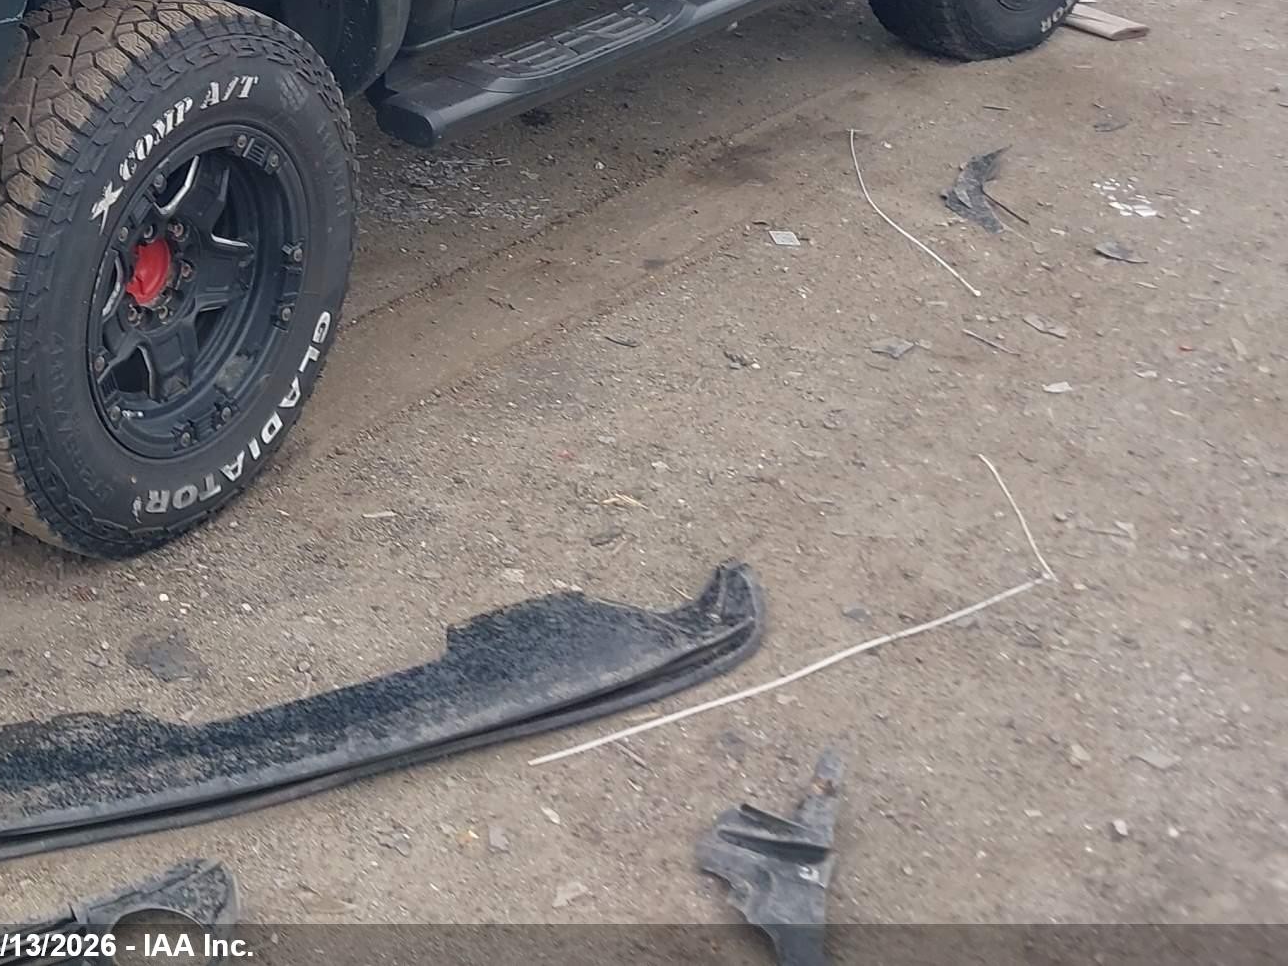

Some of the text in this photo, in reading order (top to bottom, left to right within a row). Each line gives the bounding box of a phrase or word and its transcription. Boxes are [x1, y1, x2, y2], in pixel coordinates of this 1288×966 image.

[89, 75, 259, 236] X COMP A/T
[145, 311, 331, 513] GLADIATOR
